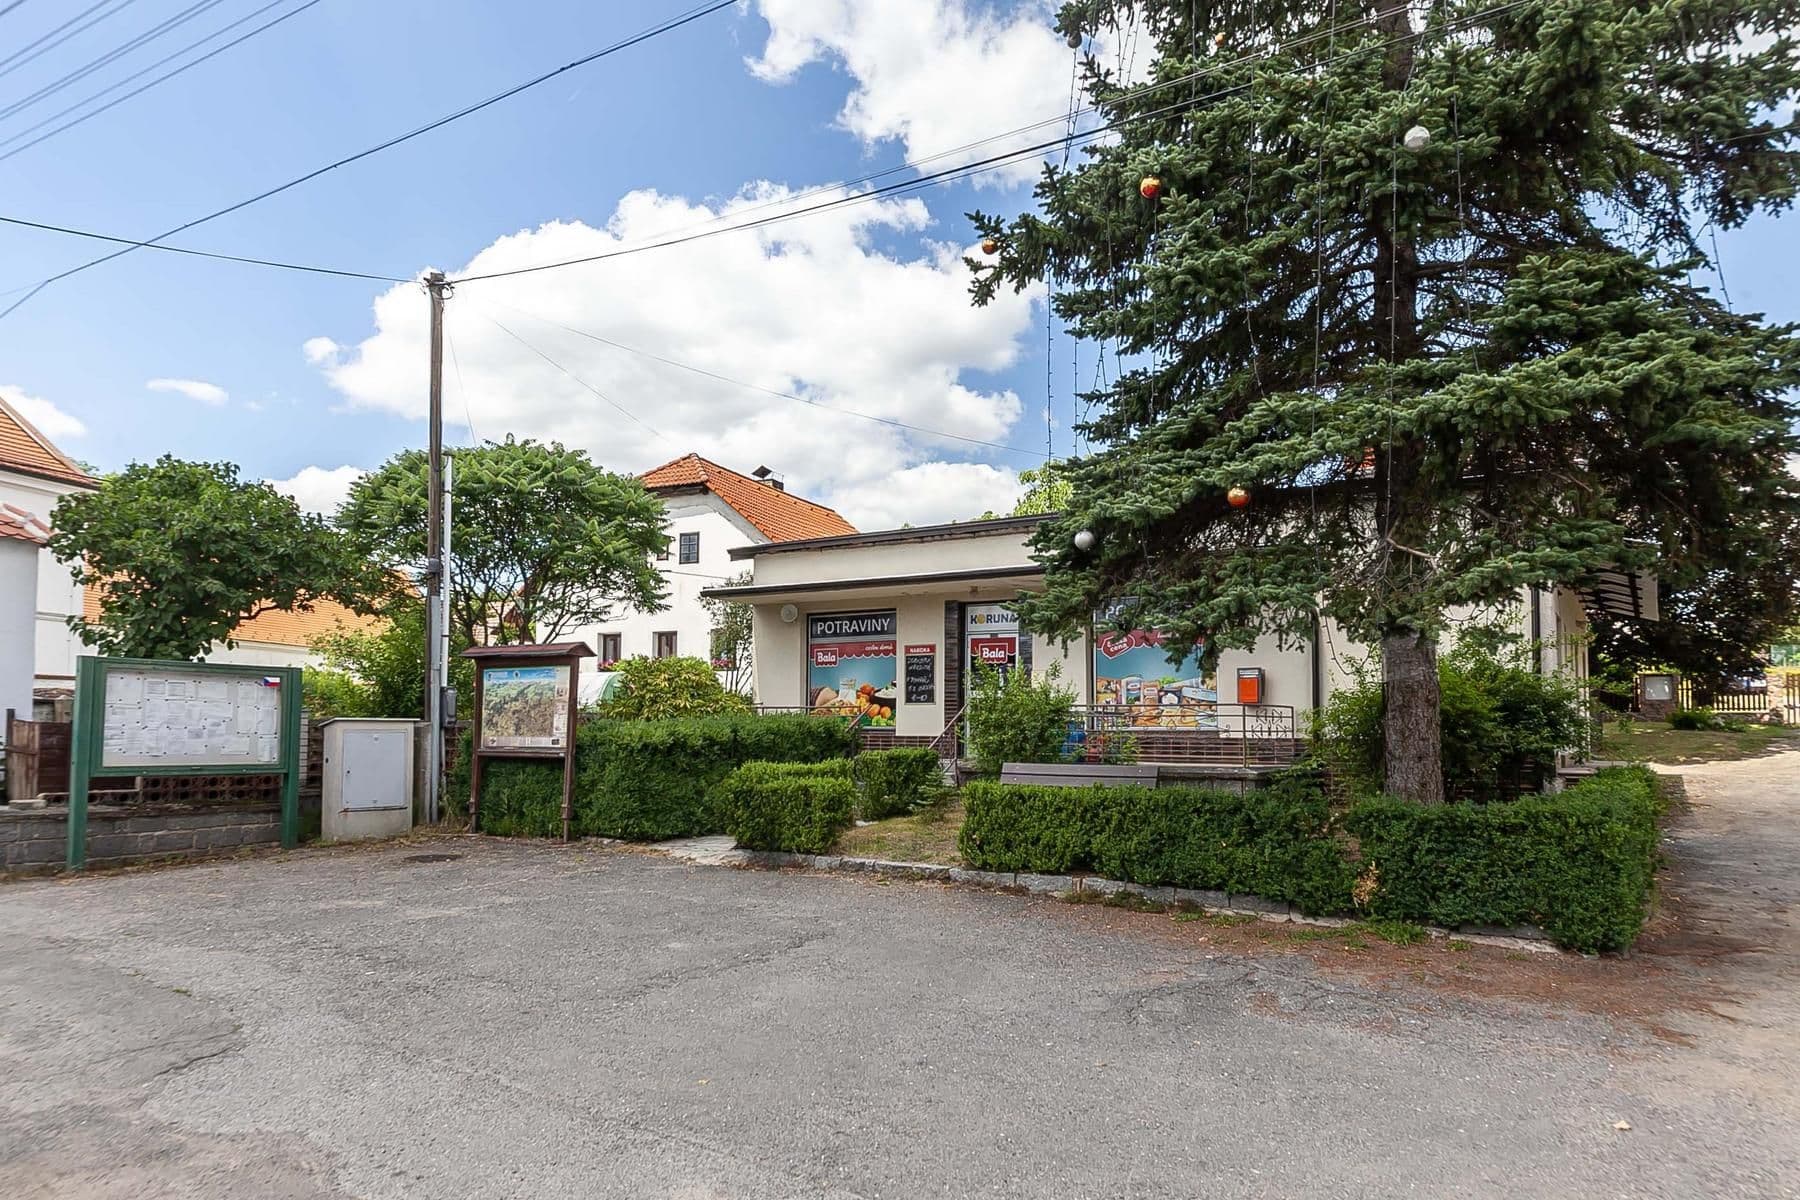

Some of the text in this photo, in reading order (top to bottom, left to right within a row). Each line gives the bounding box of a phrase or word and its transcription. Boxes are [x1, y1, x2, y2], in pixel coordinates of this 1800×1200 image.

[817, 618, 890, 634] POTRAVINY
[817, 651, 836, 663] Bala
[982, 648, 1005, 658] Bala
